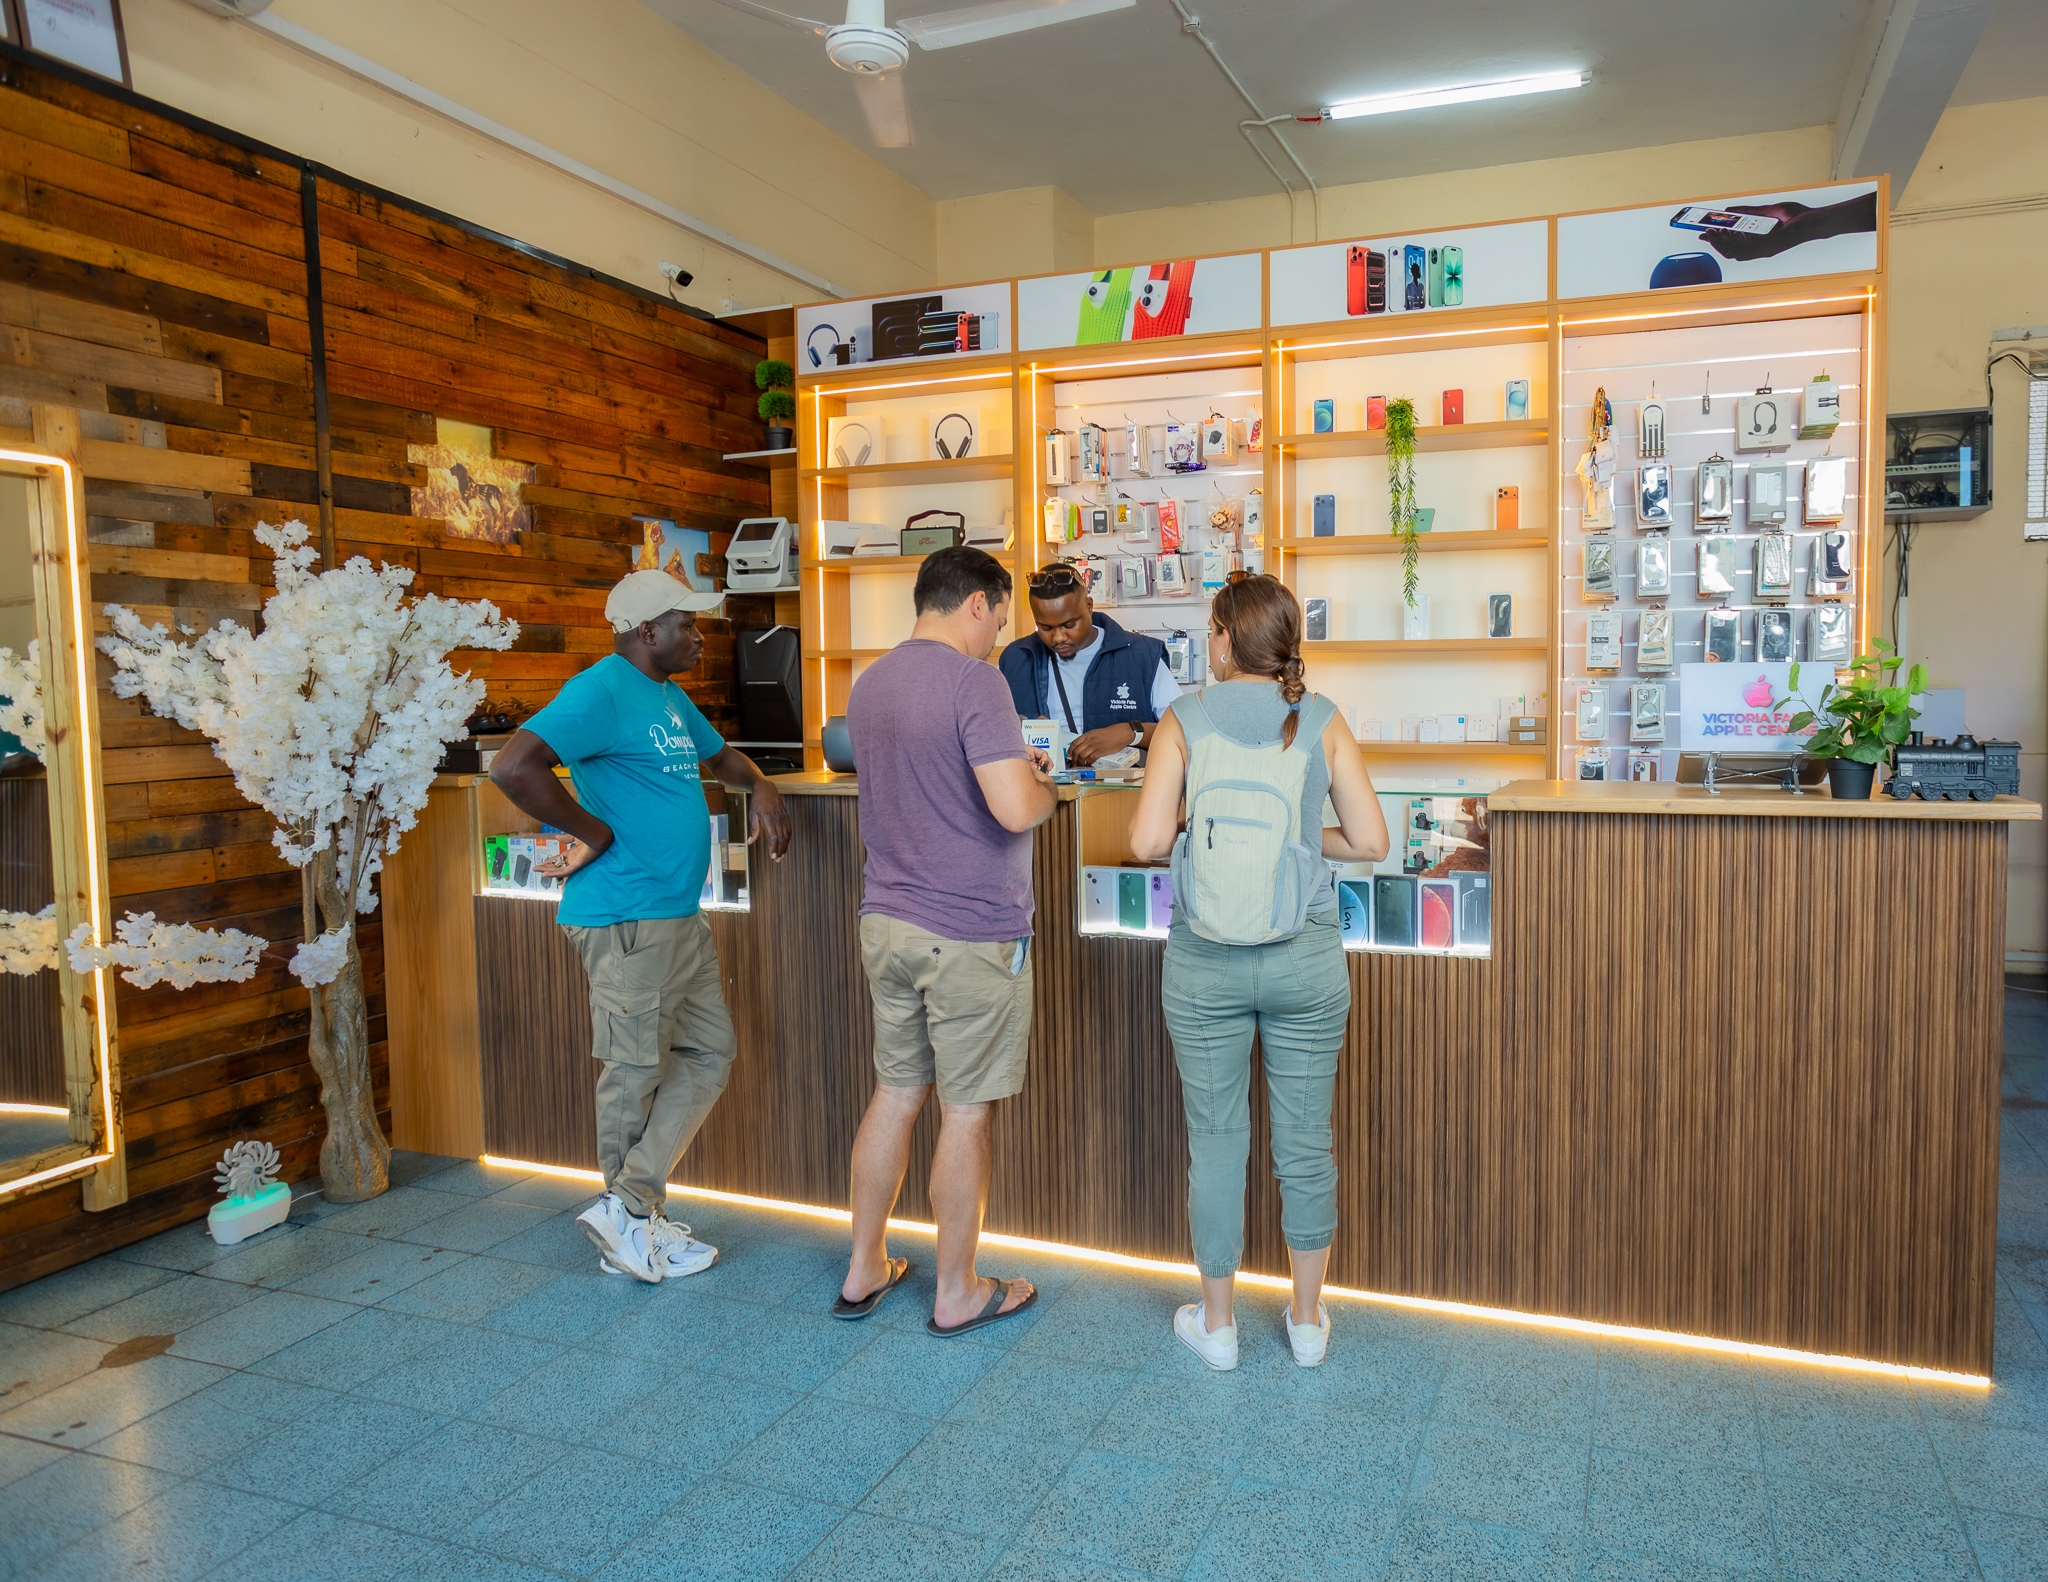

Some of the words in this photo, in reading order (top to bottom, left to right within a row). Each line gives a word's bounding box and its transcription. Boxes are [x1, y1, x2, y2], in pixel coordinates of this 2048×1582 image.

[1702, 713, 1771, 723] VICTORIA
[1702, 724, 1753, 736] APPLE
[1031, 737, 1050, 745] VISA
[663, 763, 691, 772] BEACH
